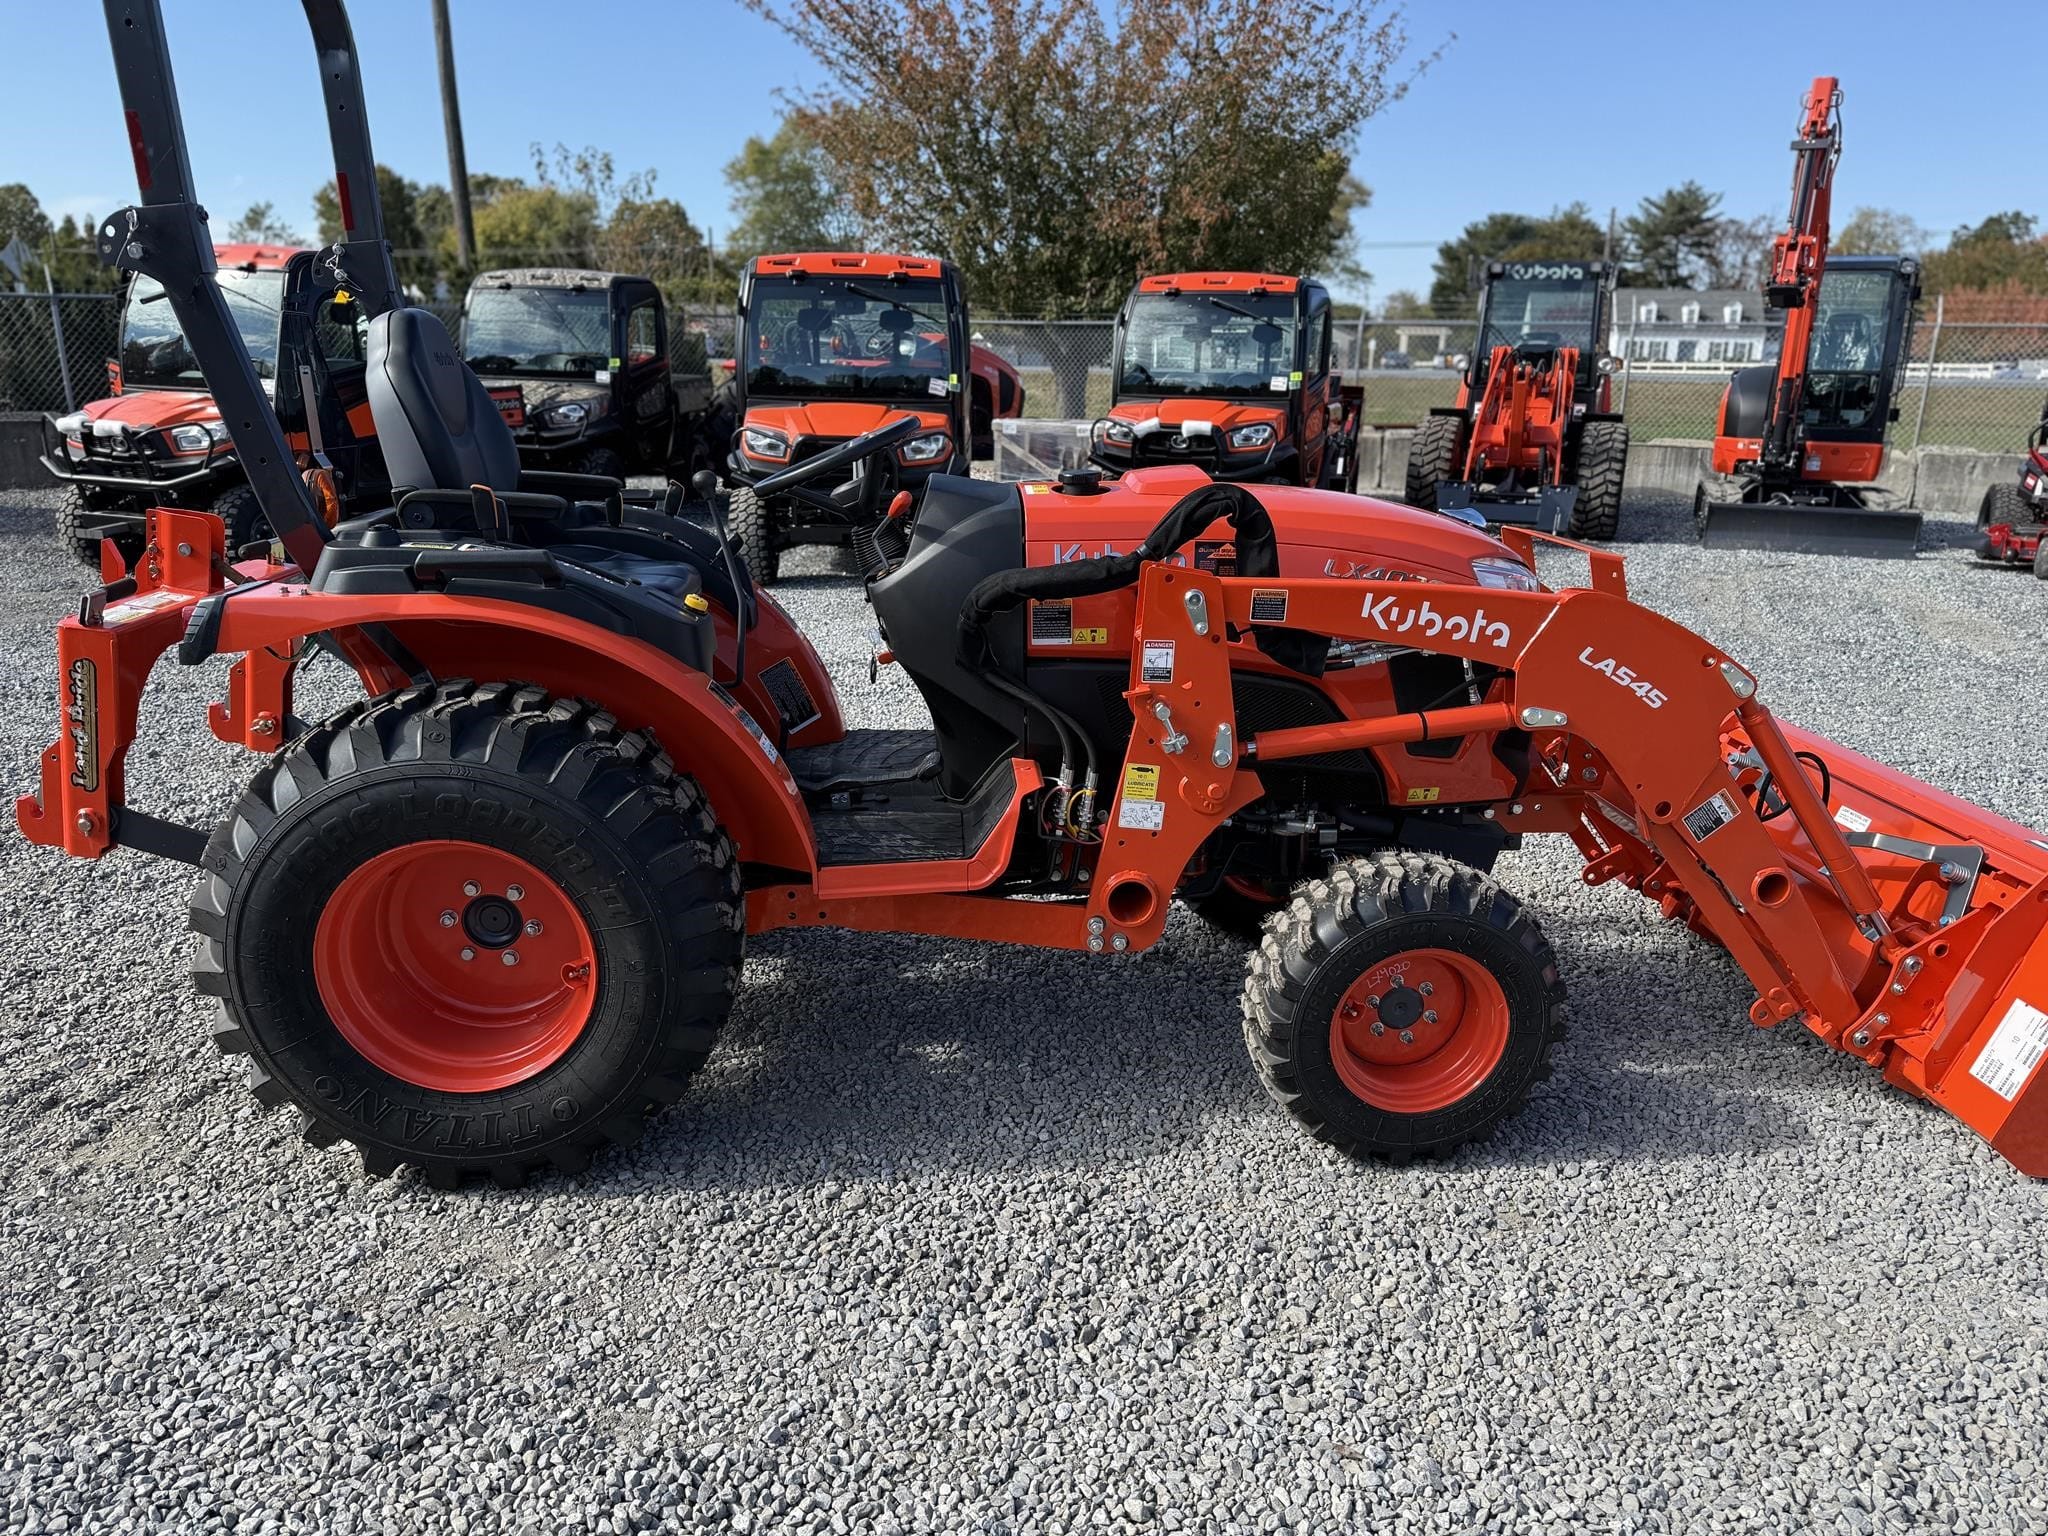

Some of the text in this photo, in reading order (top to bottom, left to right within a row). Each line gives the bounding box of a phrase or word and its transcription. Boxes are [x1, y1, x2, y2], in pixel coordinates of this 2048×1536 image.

[1505, 263, 1583, 280] Kubota
[1361, 592, 1511, 648] Kubota
[1579, 646, 1668, 709] LA545
[399, 792, 595, 878] LOADER
[1366, 961, 1411, 988] LX4020
[336, 1086, 543, 1149] TITAN
